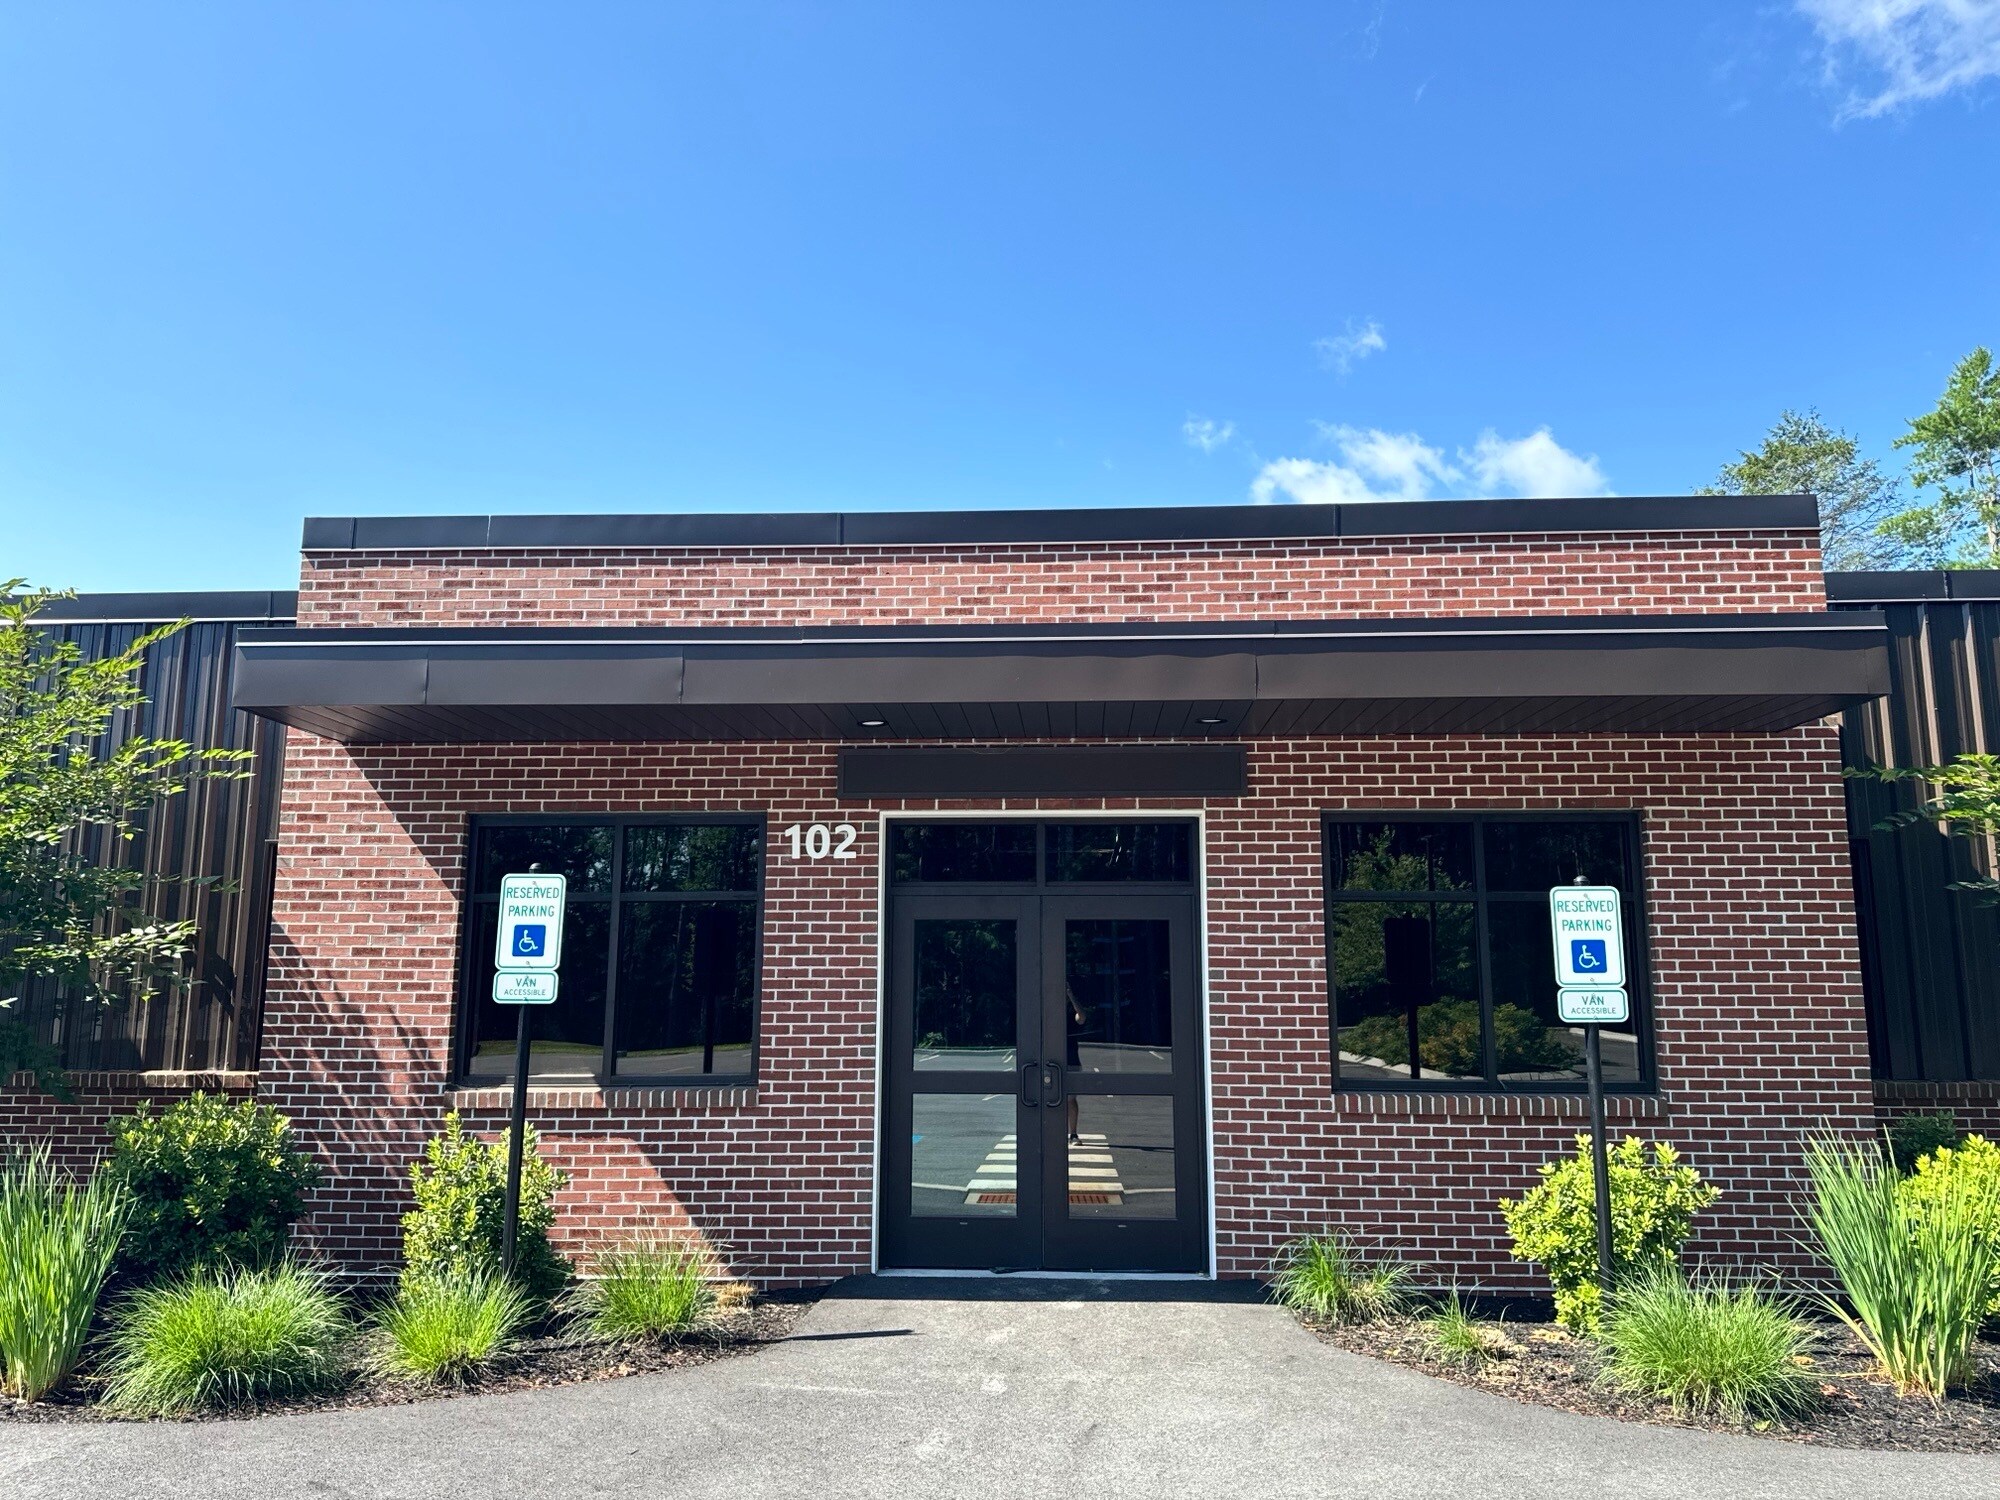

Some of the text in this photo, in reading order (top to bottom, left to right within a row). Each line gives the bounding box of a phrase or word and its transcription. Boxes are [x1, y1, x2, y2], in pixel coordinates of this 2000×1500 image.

[785, 823, 857, 860] 102
[506, 887, 559, 899] RESERVED
[508, 905, 555, 917] PARKING
[1557, 900, 1614, 912] RESERVED
[1562, 919, 1612, 931] PARKING
[515, 978, 537, 987] VAN
[504, 988, 546, 996] ACCESSIBLE
[1581, 996, 1604, 1005] VAN
